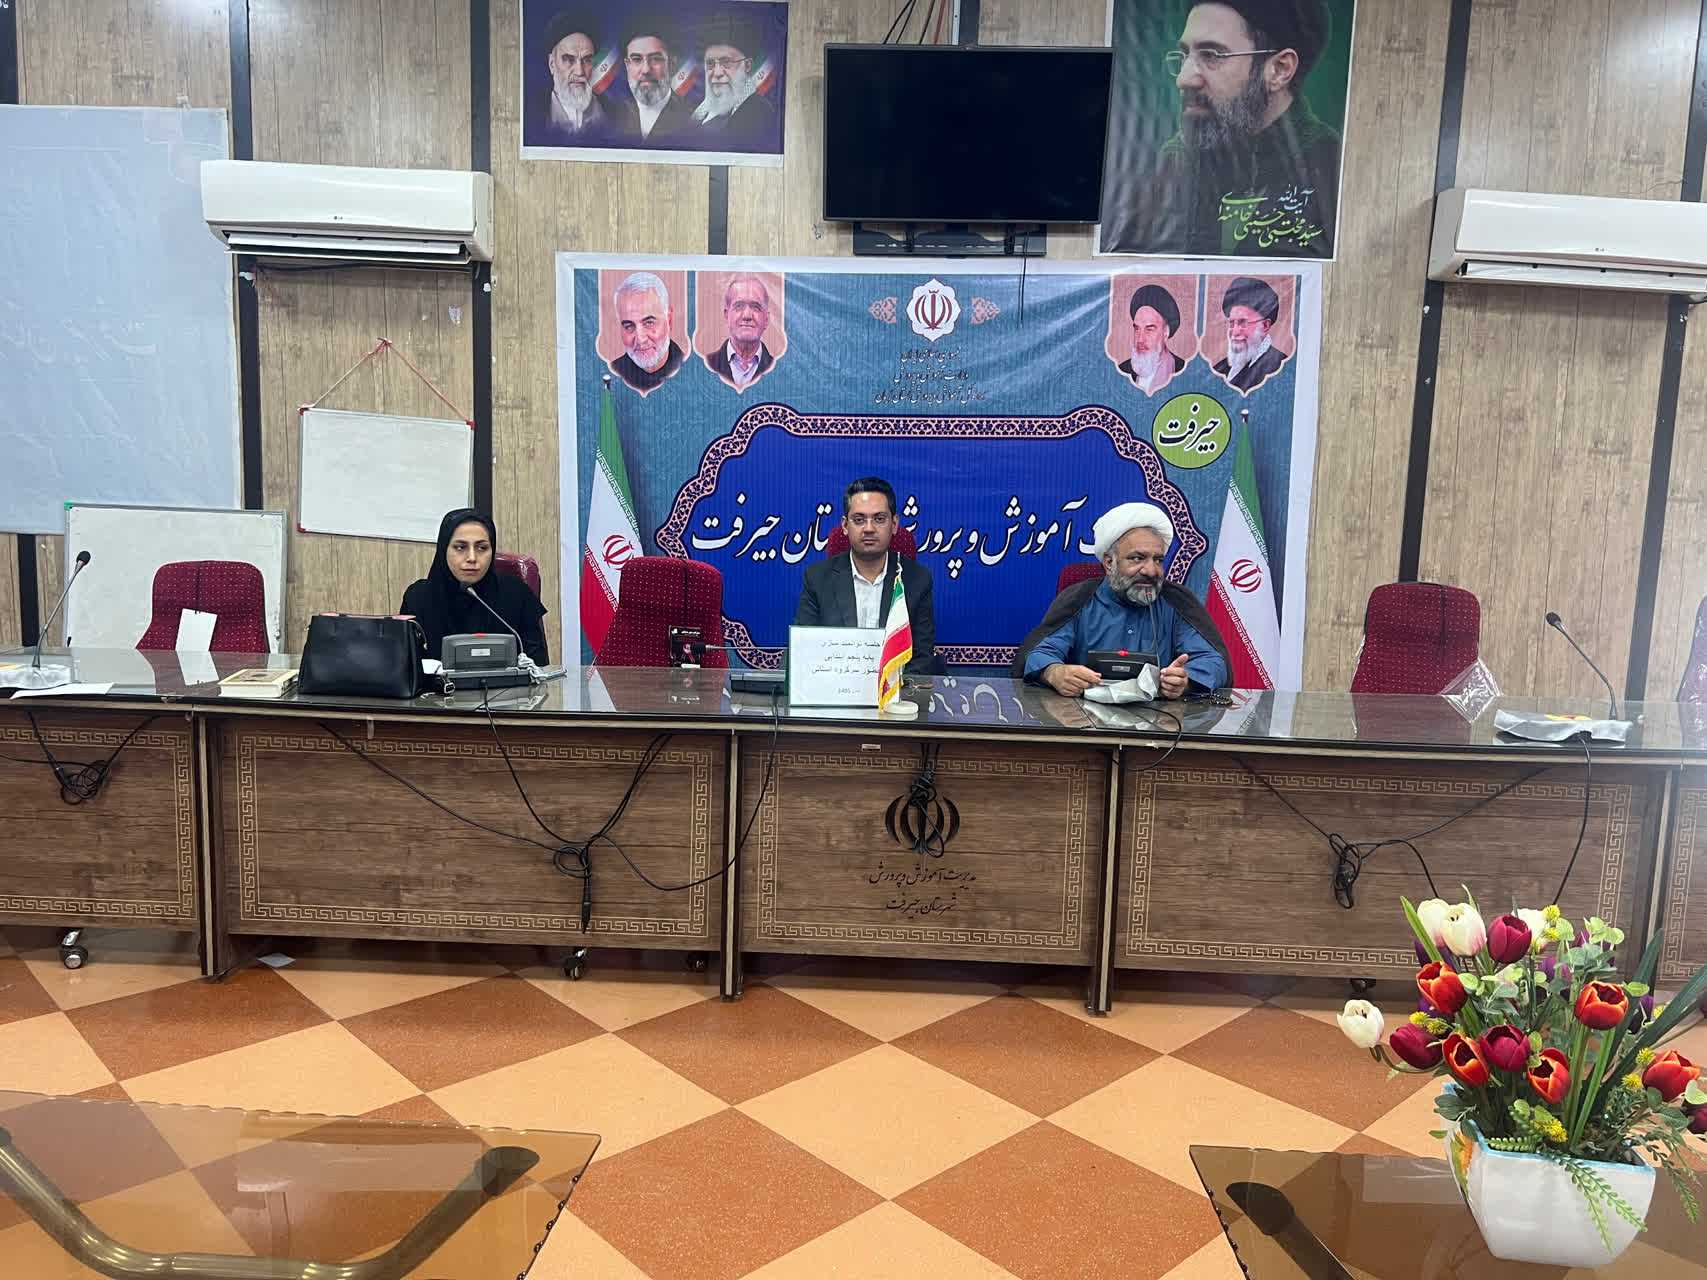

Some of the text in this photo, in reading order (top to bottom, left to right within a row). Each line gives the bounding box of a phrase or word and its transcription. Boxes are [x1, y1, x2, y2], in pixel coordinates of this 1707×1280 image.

[1158, 402, 1221, 454] جیرفت
[691, 492, 781, 562] جیرفت
[979, 495, 1089, 566] آموزش
[965, 529, 979, 554] و
[906, 863, 947, 885] آموزش
[943, 868, 977, 890] مدیریت
[886, 892, 957, 919] شهرستان جیرفت
